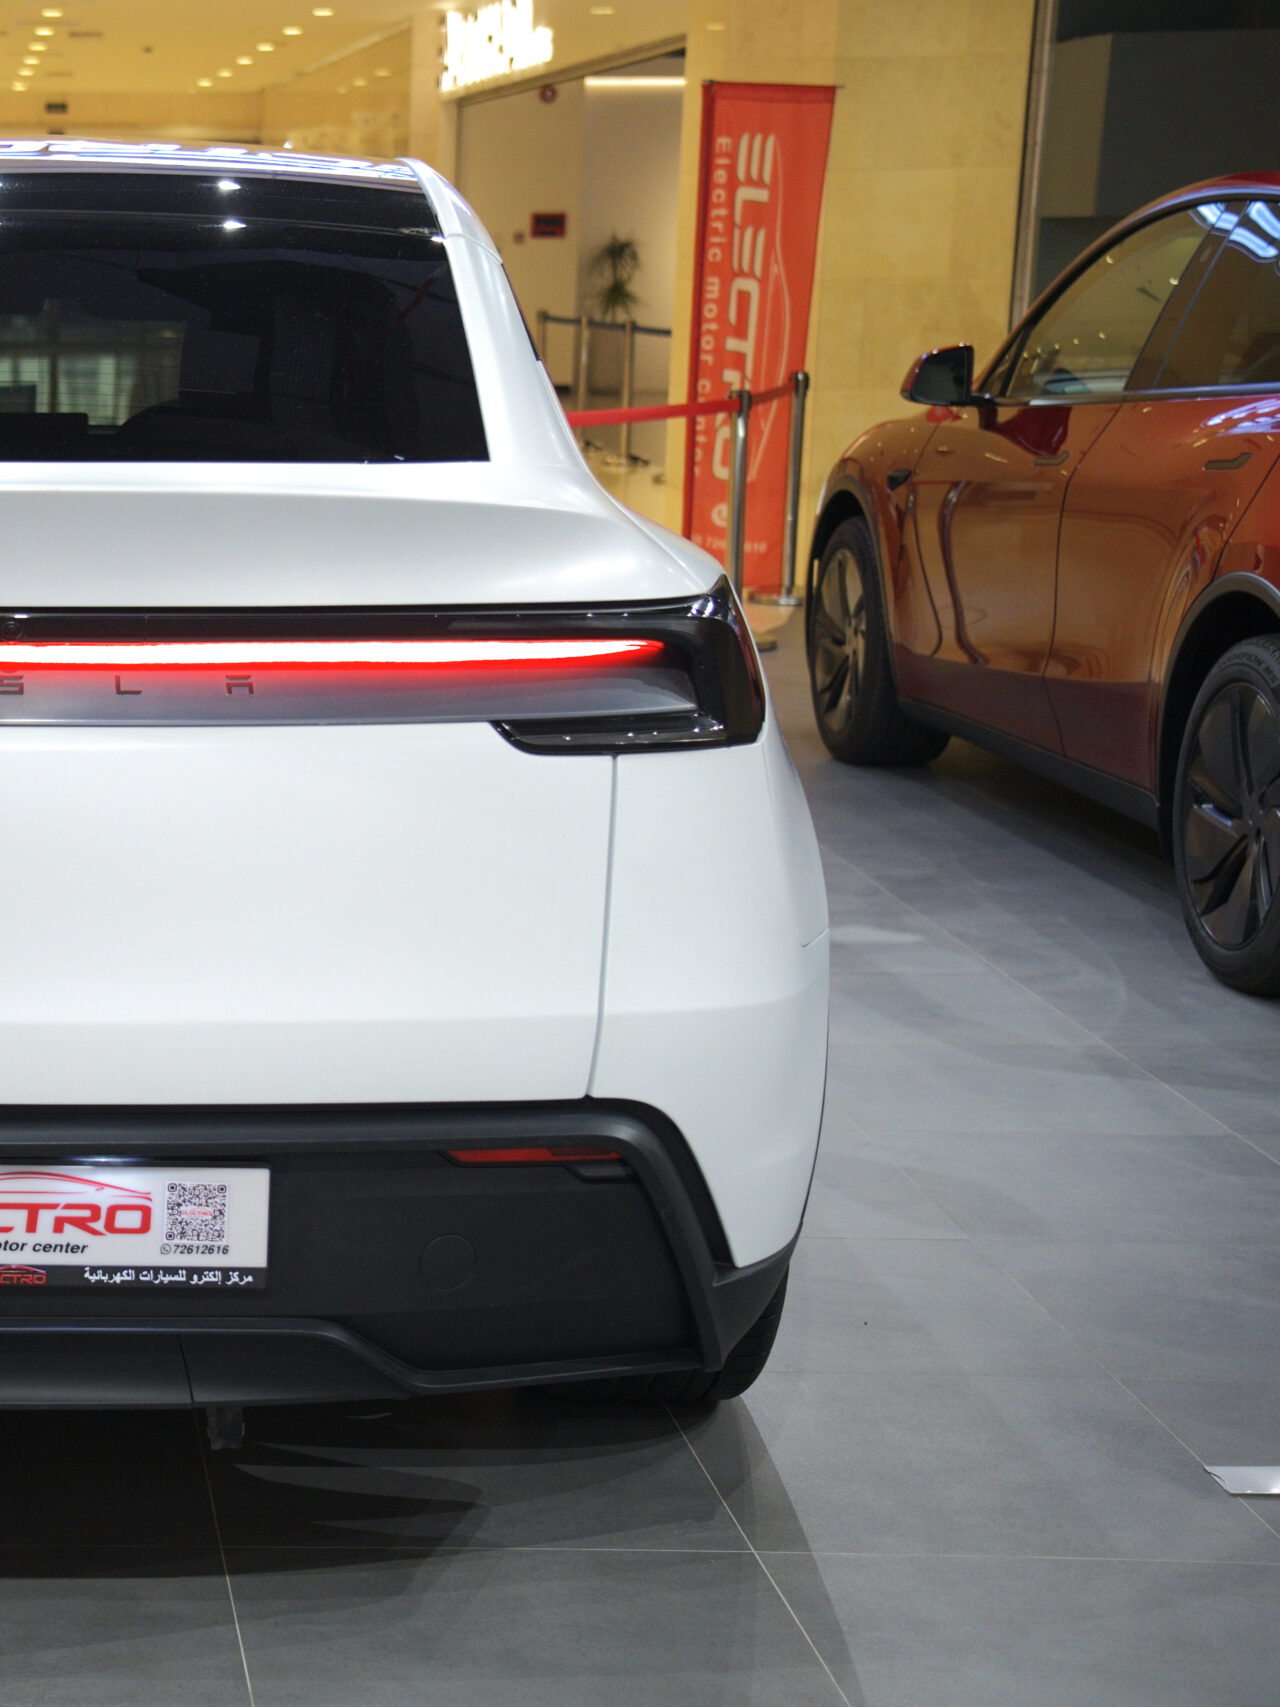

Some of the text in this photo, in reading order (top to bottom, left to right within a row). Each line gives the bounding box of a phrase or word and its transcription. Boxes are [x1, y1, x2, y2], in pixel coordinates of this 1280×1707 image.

[693, 136, 733, 478] Electric motor cnter
[32, 1241, 89, 1255] center
[173, 1244, 230, 1255] 72612616
[83, 1266, 254, 1286] مركز إلكترو للسيارات الكهربائية
